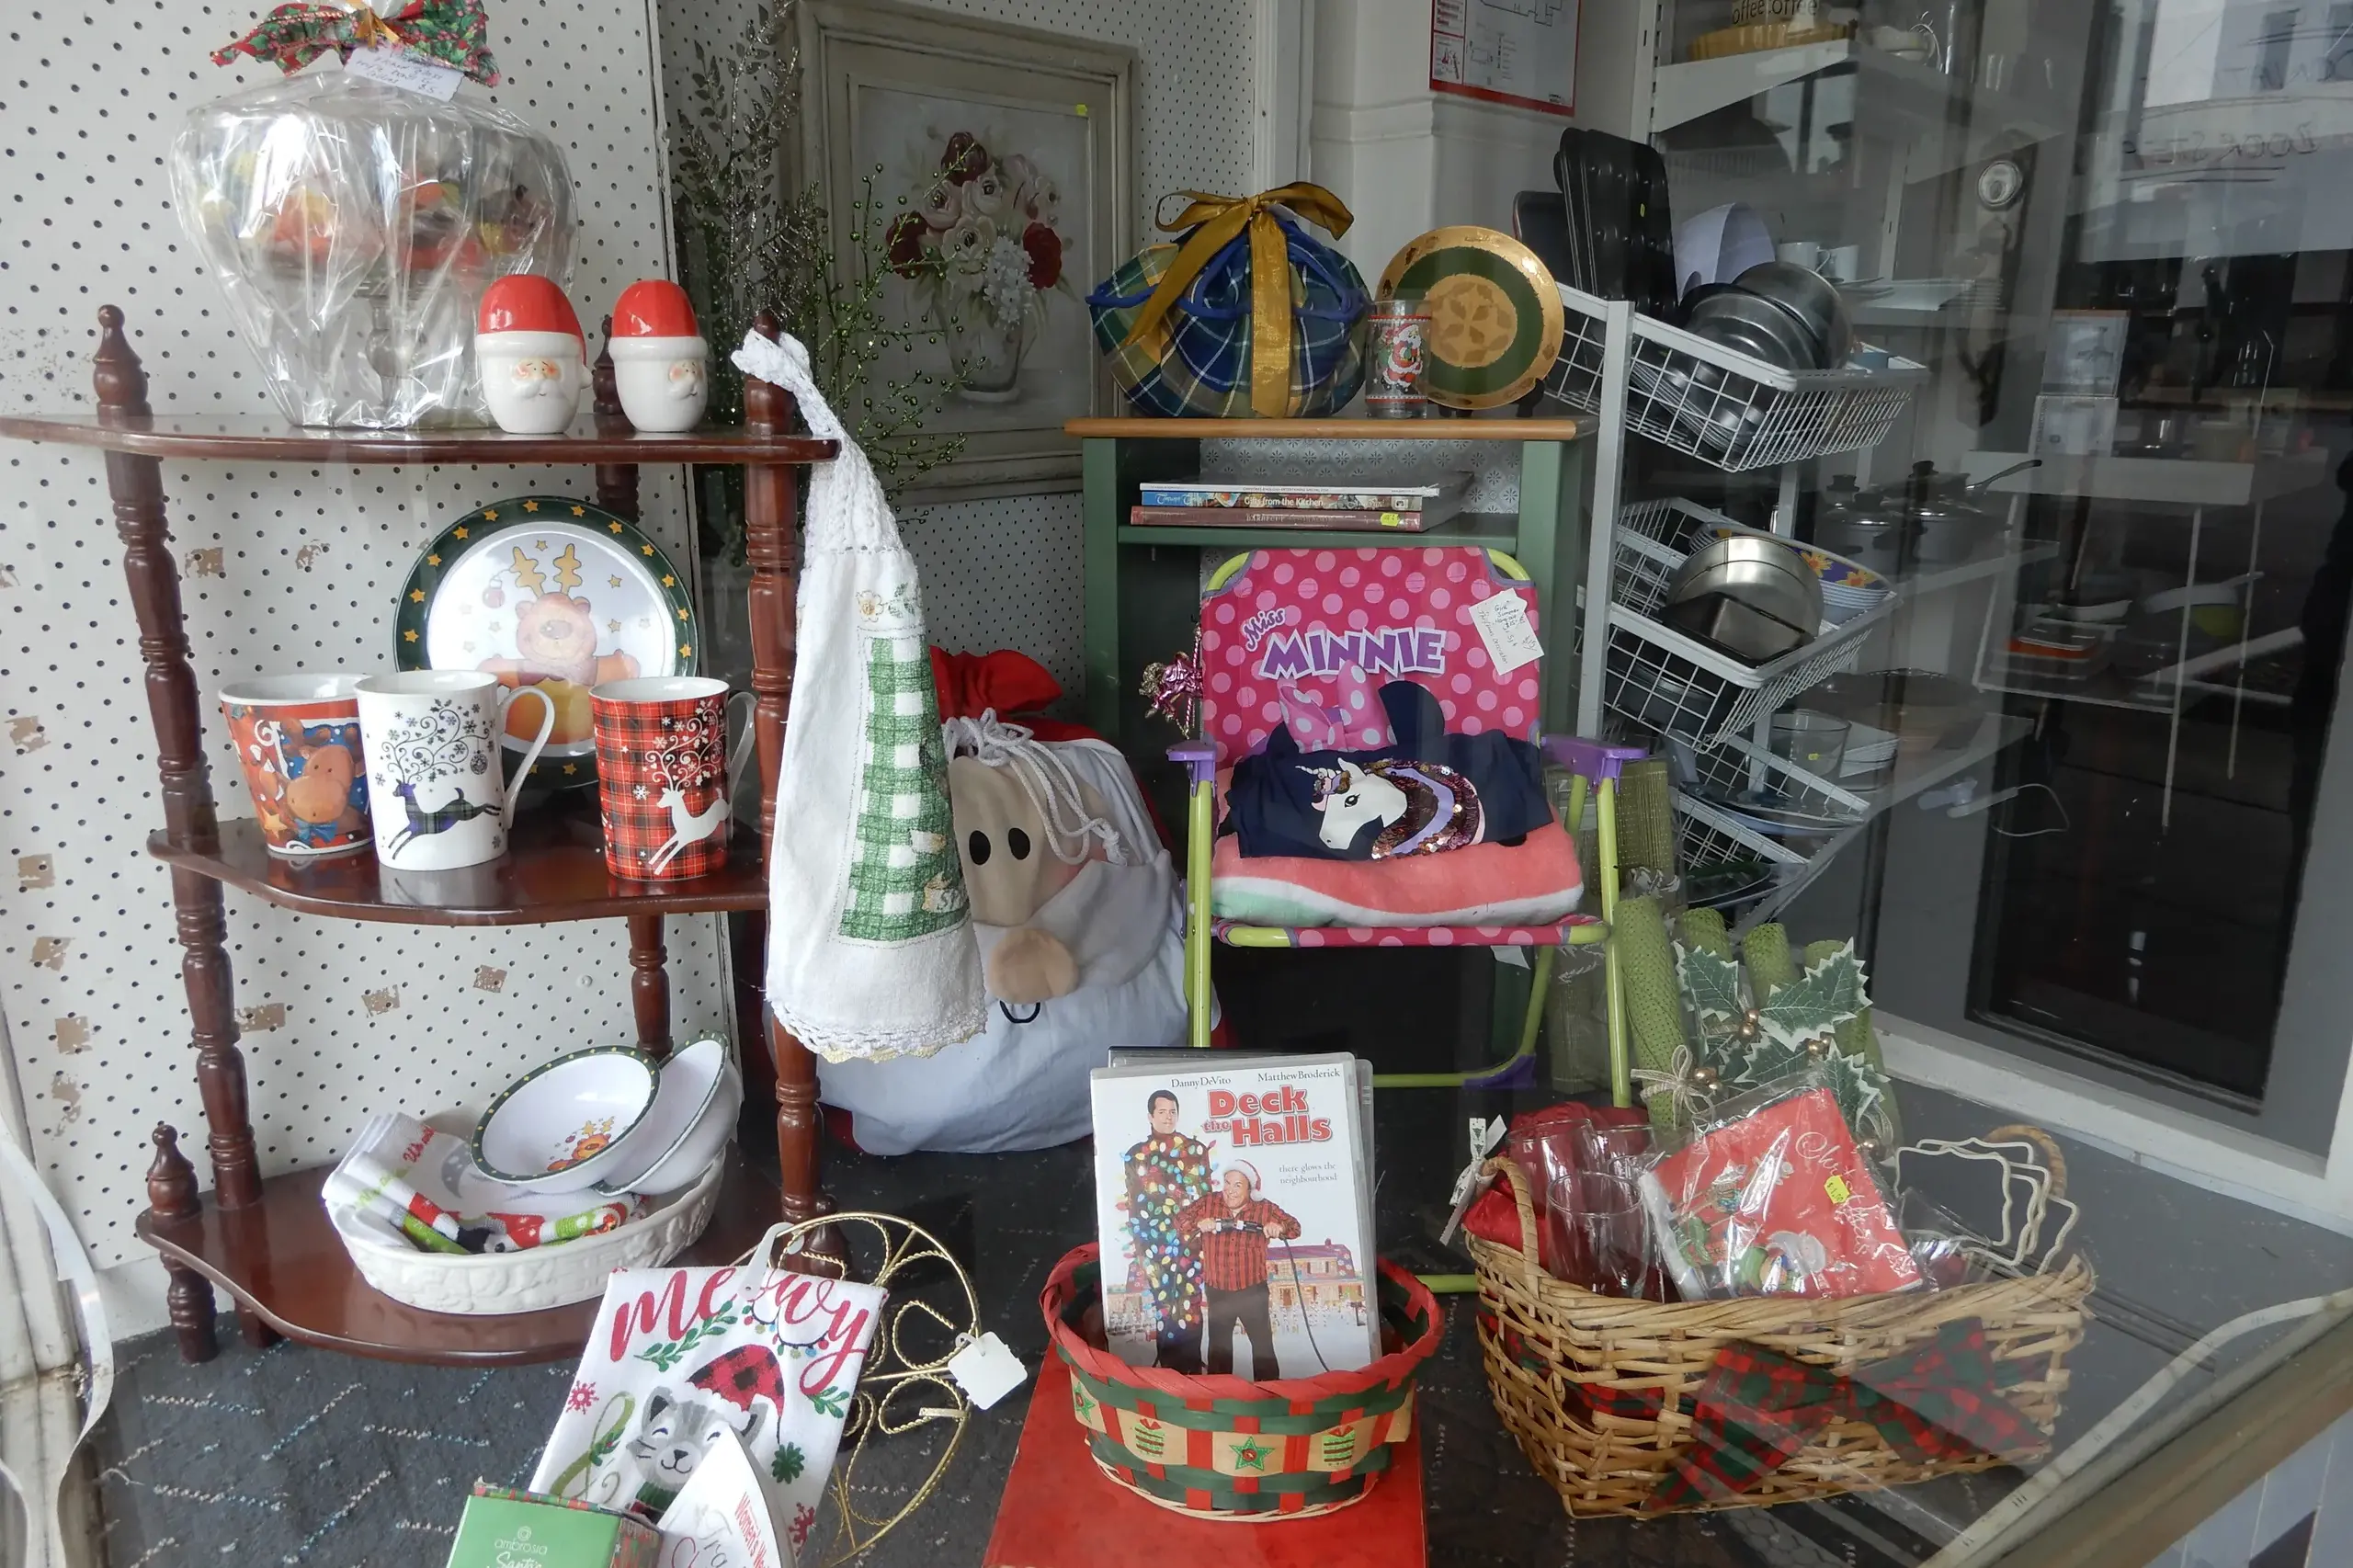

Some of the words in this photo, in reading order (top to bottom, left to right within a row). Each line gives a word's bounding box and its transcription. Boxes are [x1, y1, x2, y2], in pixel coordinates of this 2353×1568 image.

[1262, 497, 1279, 506] from
[1281, 497, 1294, 506] the
[1296, 497, 1324, 507] Kitchen
[1243, 608, 1286, 652] Miss
[1260, 628, 1446, 679] MINNIE
[1171, 1078, 1199, 1089] Danny
[1200, 1076, 1232, 1086] DeVito
[1257, 1071, 1299, 1083] Matthew
[1298, 1068, 1341, 1080] Broderick
[1207, 1085, 1309, 1119] Deck
[1203, 1119, 1230, 1132] the
[1230, 1114, 1334, 1148] Halls
[1324, 1162, 1336, 1170] the
[1279, 1173, 1337, 1186] neighbourhood
[494, 1538, 548, 1555] ambrosia
